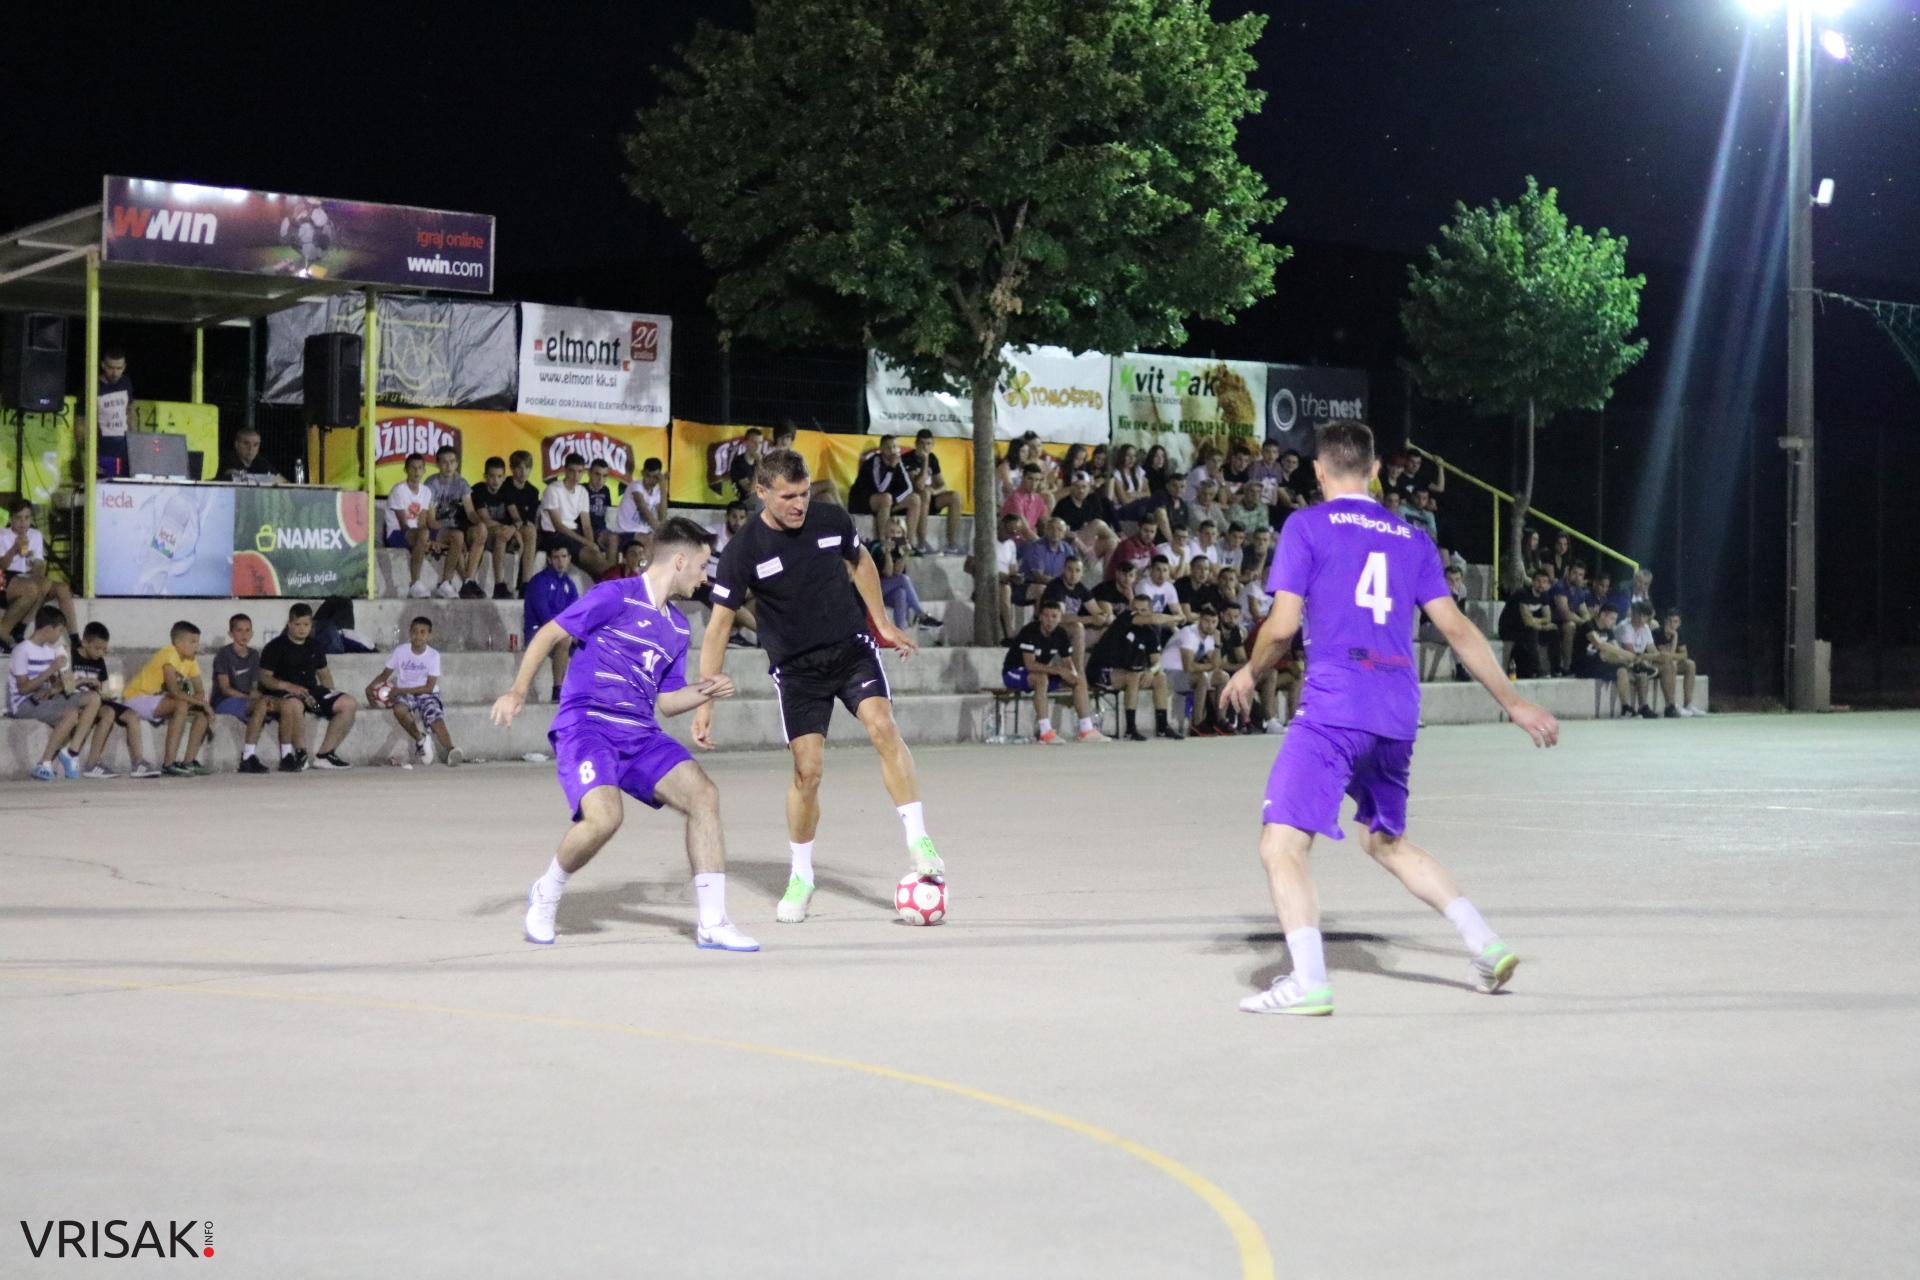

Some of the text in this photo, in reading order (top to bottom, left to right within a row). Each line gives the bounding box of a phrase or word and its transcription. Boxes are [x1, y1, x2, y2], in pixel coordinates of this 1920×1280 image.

[416, 227, 484, 249] igraj online
[407, 253, 484, 278] wwin.com
[546, 330, 621, 366] elmont
[631, 326, 657, 349] 20
[1328, 512, 1412, 539] KNEŠPOLJE
[277, 527, 343, 550] NAMEX
[1354, 551, 1393, 625] 4
[578, 760, 597, 785] 8
